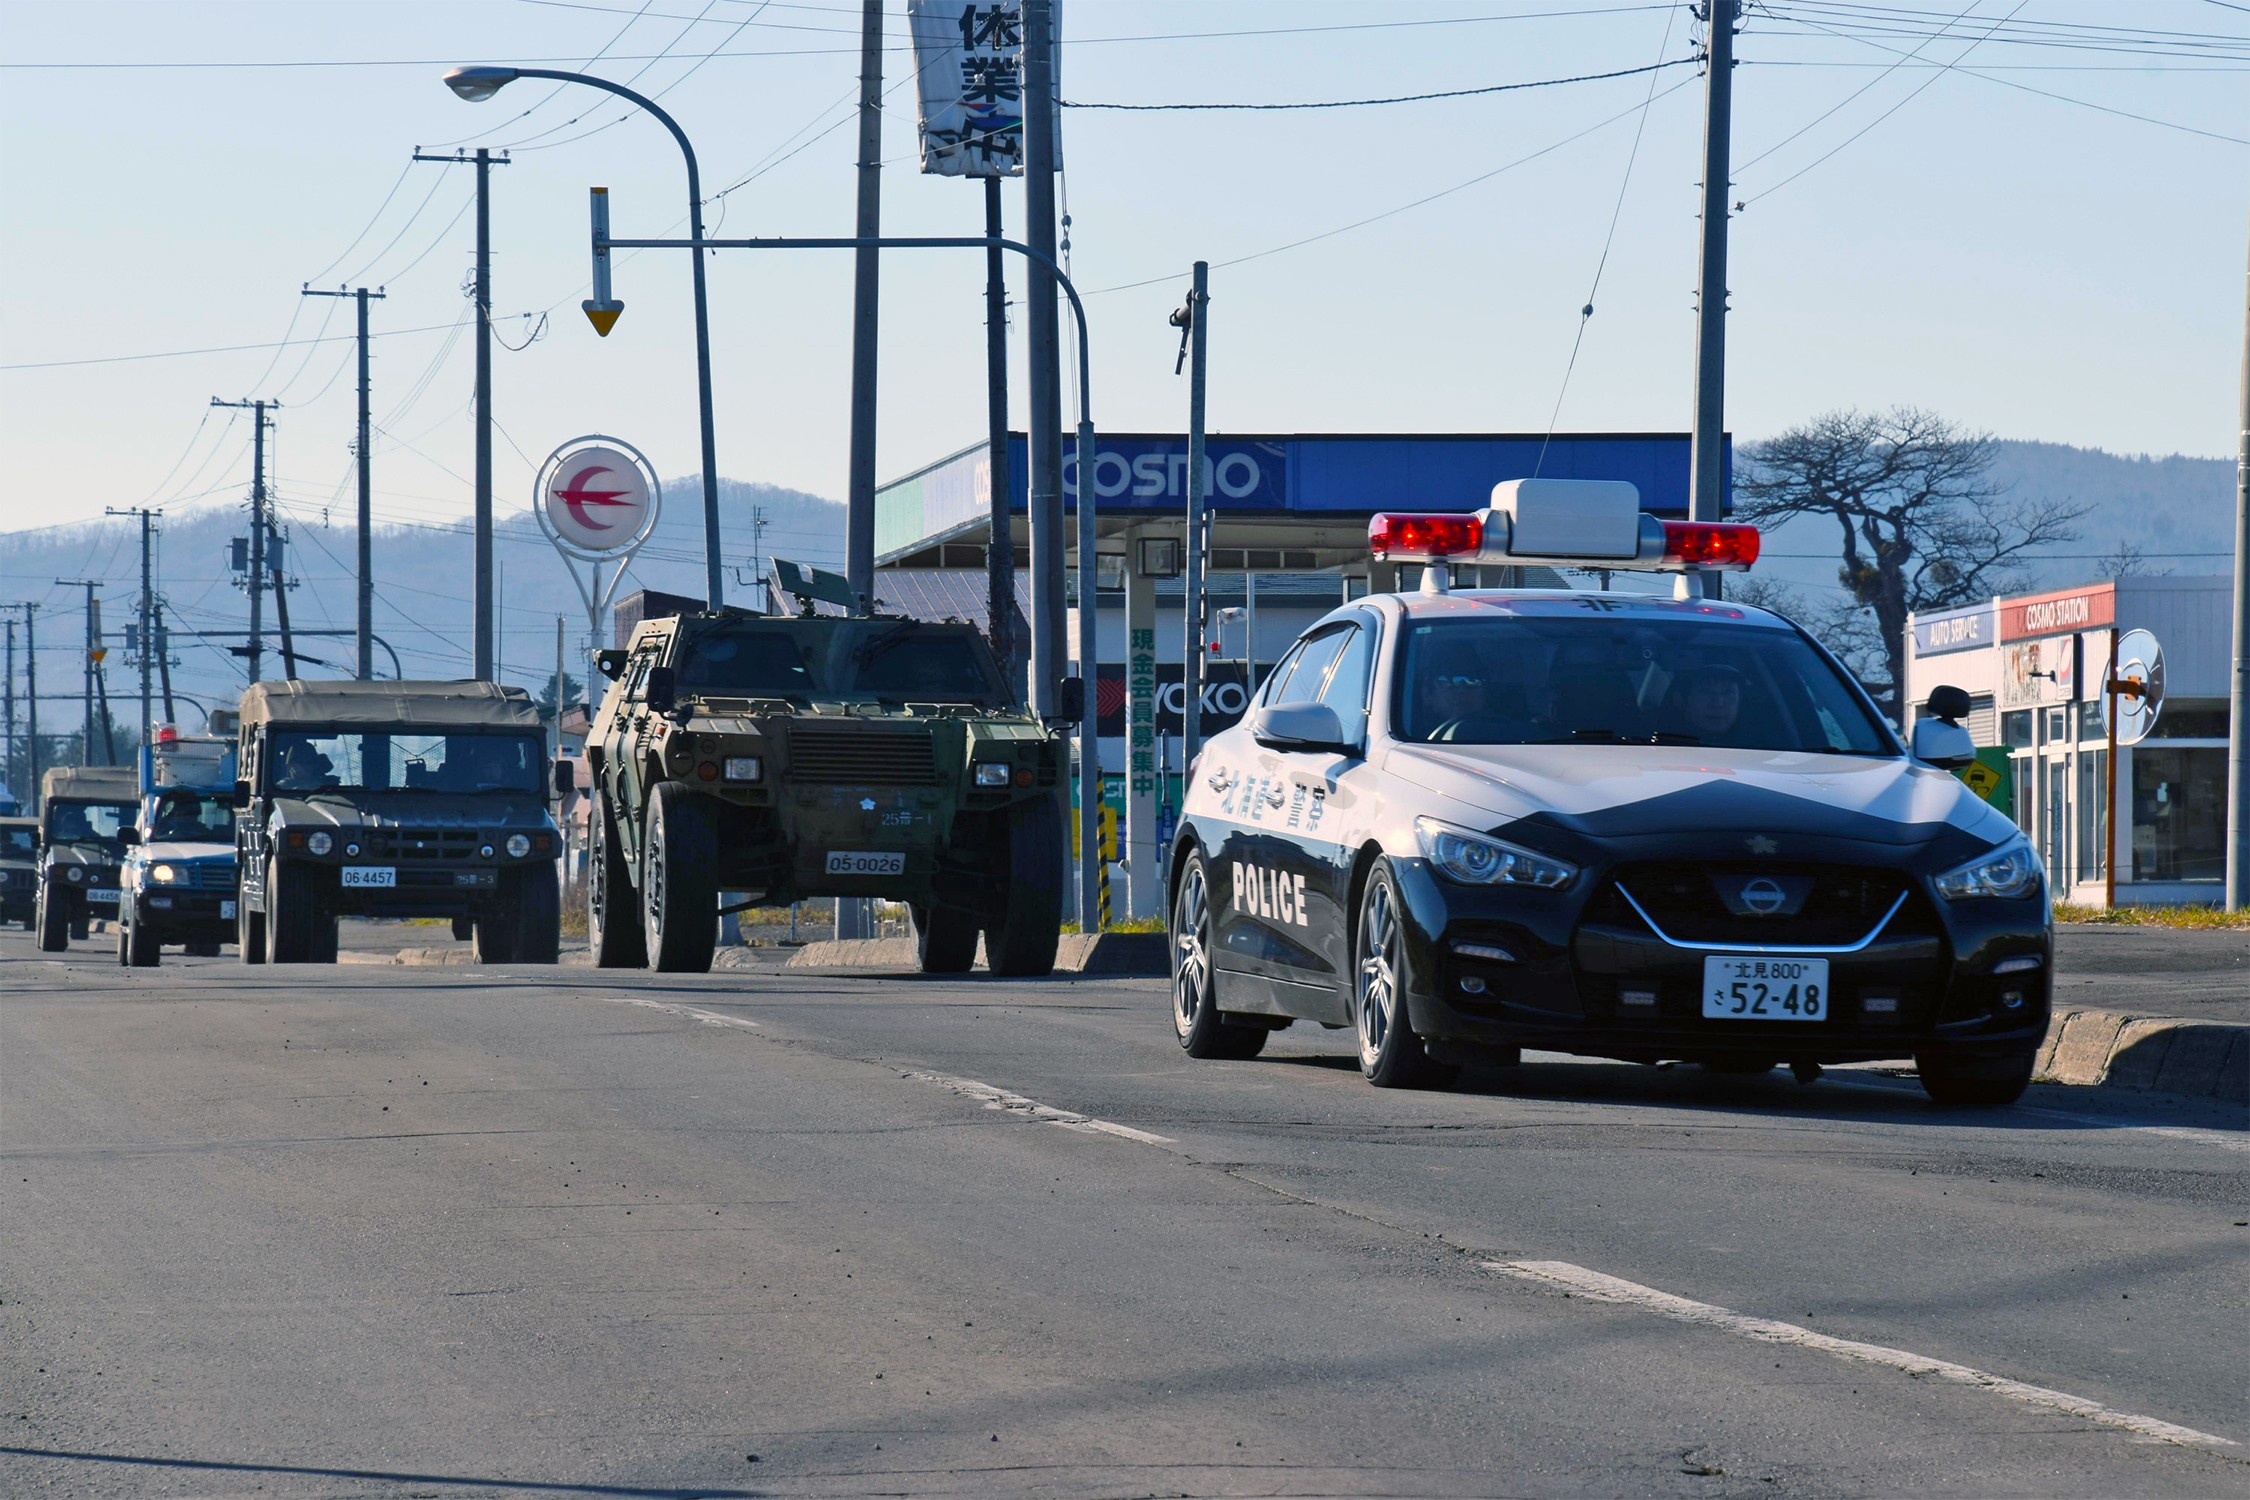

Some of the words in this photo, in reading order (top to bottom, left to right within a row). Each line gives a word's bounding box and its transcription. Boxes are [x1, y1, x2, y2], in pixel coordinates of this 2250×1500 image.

[2027, 601, 2055, 631] COSMO
[2056, 596, 2089, 626] STATION
[1930, 620, 1949, 647] AUTO
[1951, 615, 1978, 643] SERVICE
[1132, 628, 1154, 798] 現金会員募集中
[830, 857, 900, 872] 05-0026
[1232, 861, 1308, 927] POLICE
[1731, 982, 1820, 1015] 52-48
